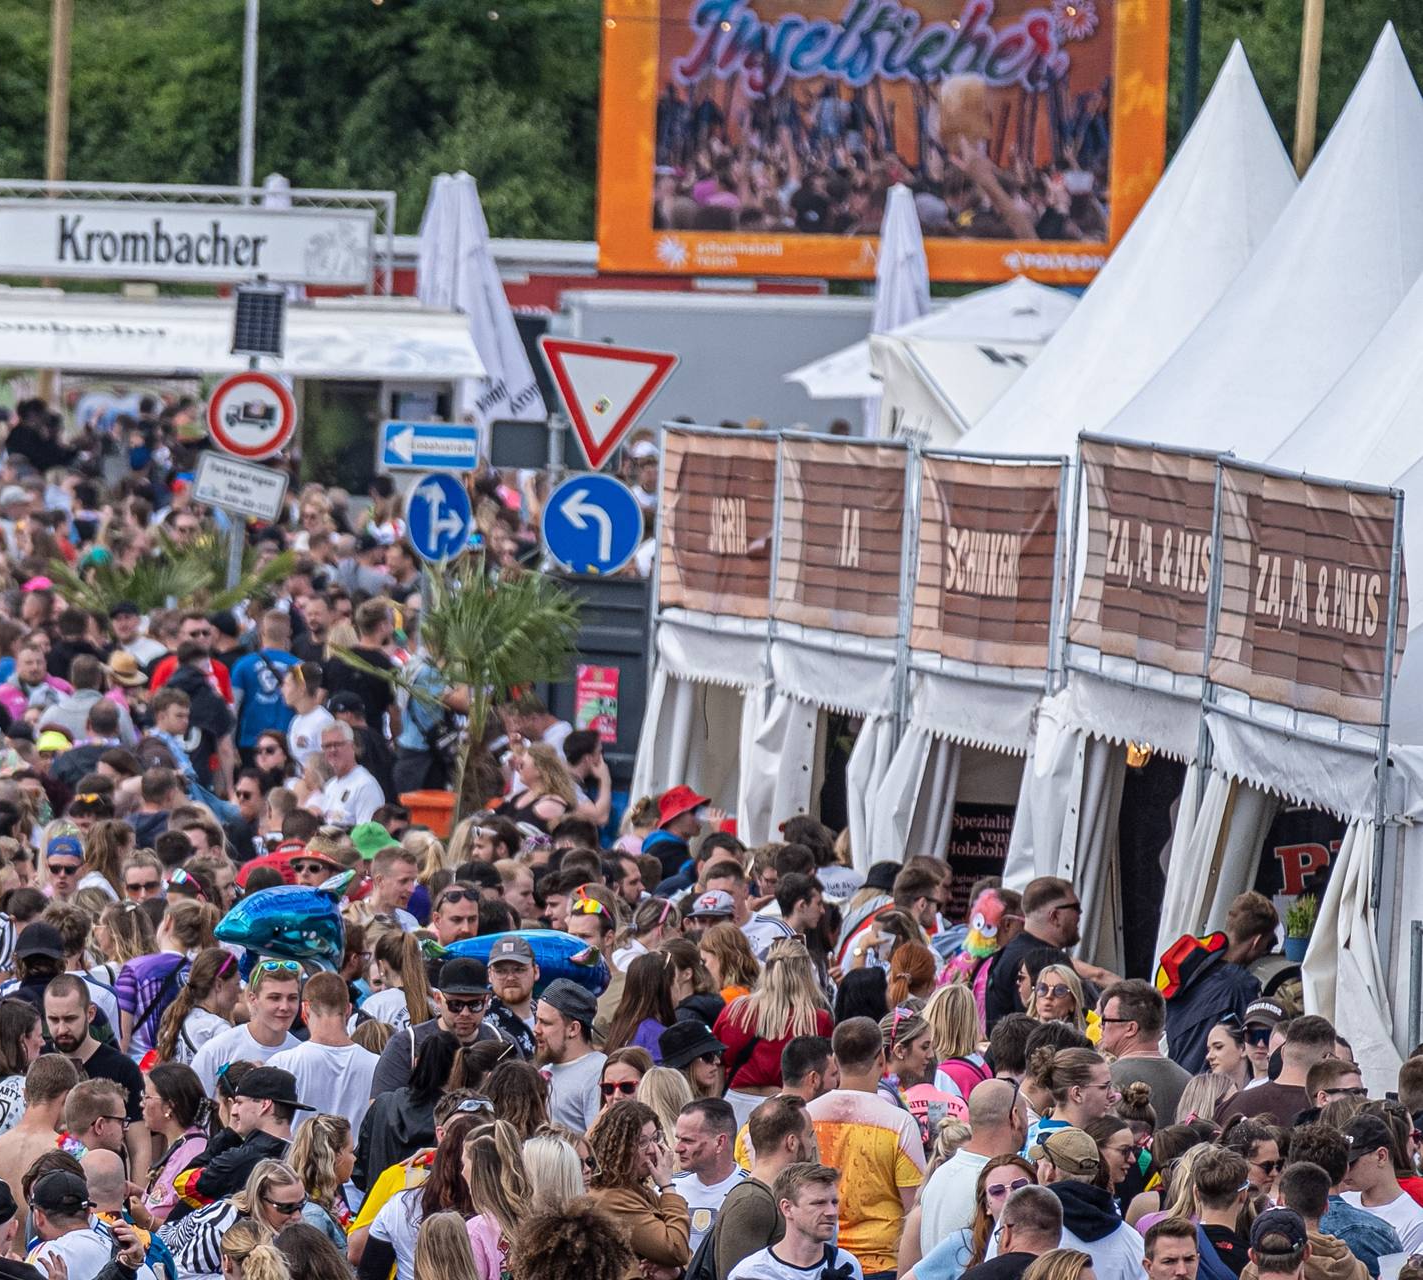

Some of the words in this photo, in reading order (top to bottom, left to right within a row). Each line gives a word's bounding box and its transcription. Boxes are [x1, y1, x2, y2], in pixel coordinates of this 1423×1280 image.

[57, 214, 267, 267] Krombacher
[1159, 528, 1174, 587] &
[1316, 565, 1329, 627] &
